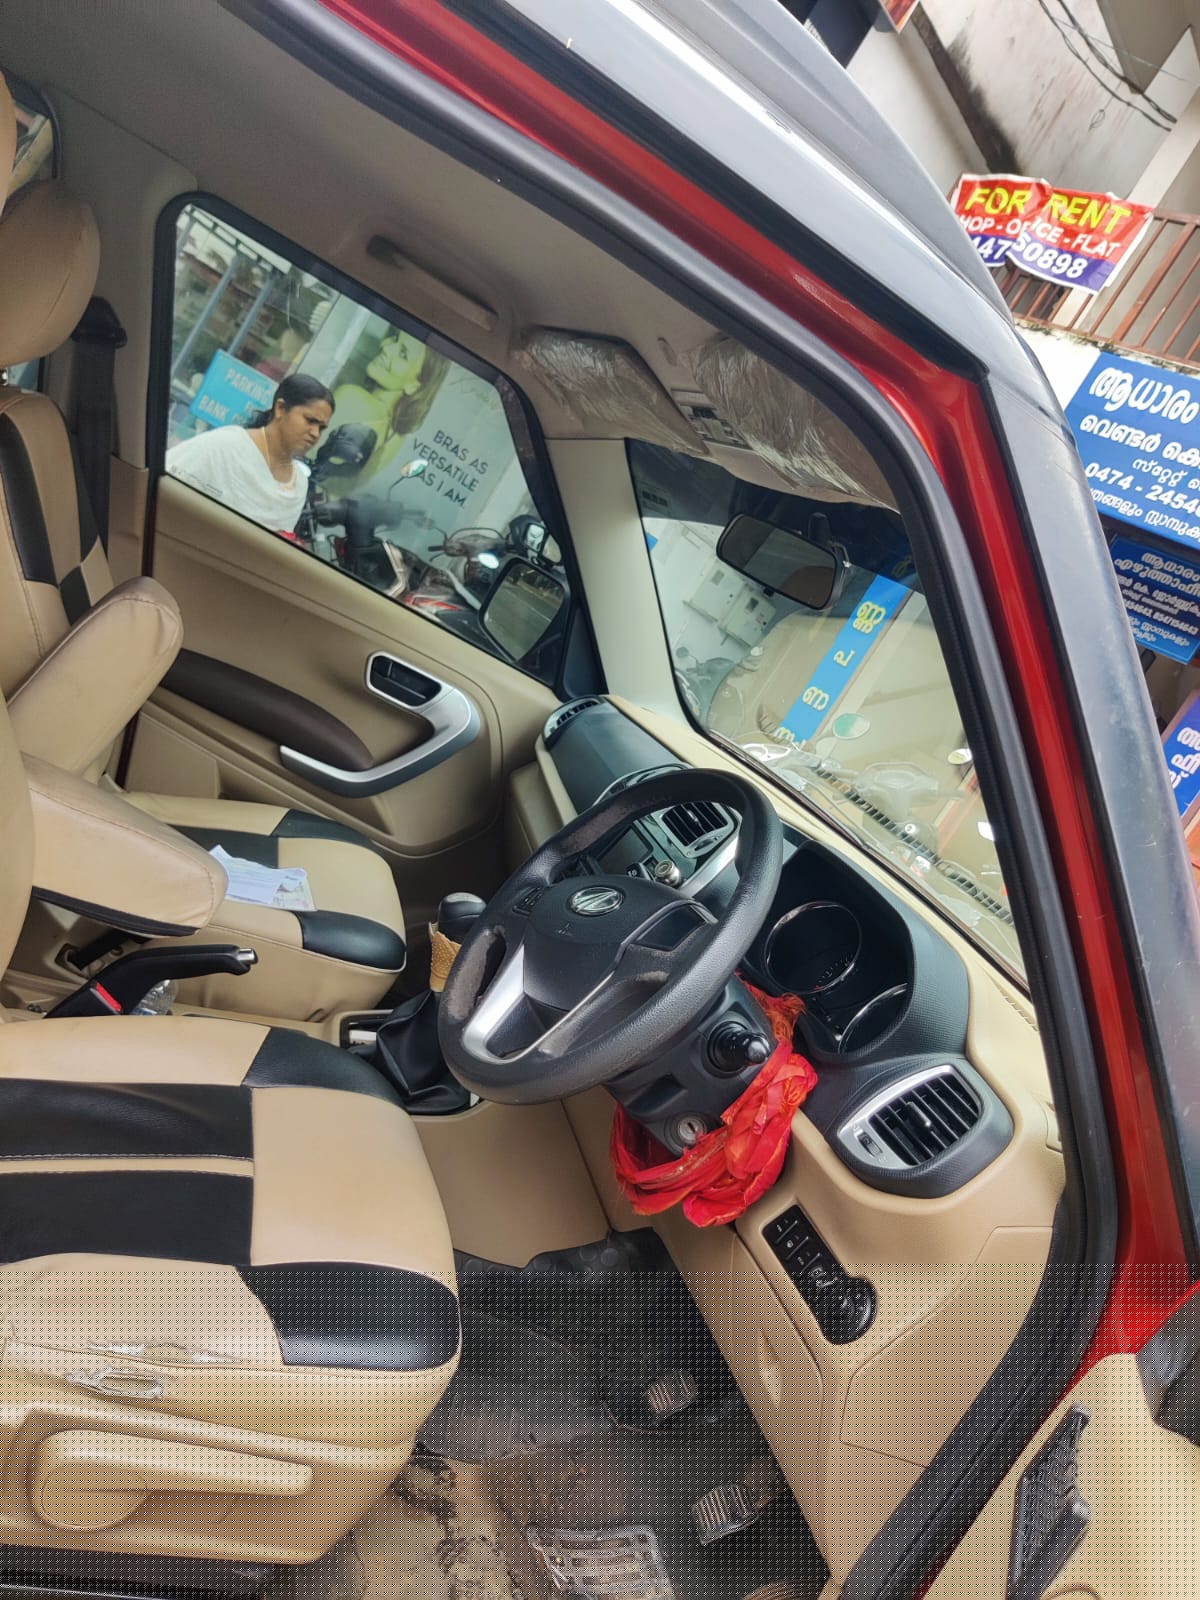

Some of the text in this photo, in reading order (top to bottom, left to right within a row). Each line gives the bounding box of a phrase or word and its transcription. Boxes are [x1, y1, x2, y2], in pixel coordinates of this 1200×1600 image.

[965, 187, 1132, 235] FOR RENT
[959, 214, 996, 232] HOP
[1005, 217, 1064, 244] OFICE
[1071, 233, 1121, 258] FLAT
[198, 394, 231, 423] BANK
[1089, 367, 1200, 424] ആധാരം
[412, 437, 480, 492] VERSATILE
[433, 429, 489, 475] BRAS AS
[436, 480, 444, 492] I
[1085, 462, 1134, 490] 0474
